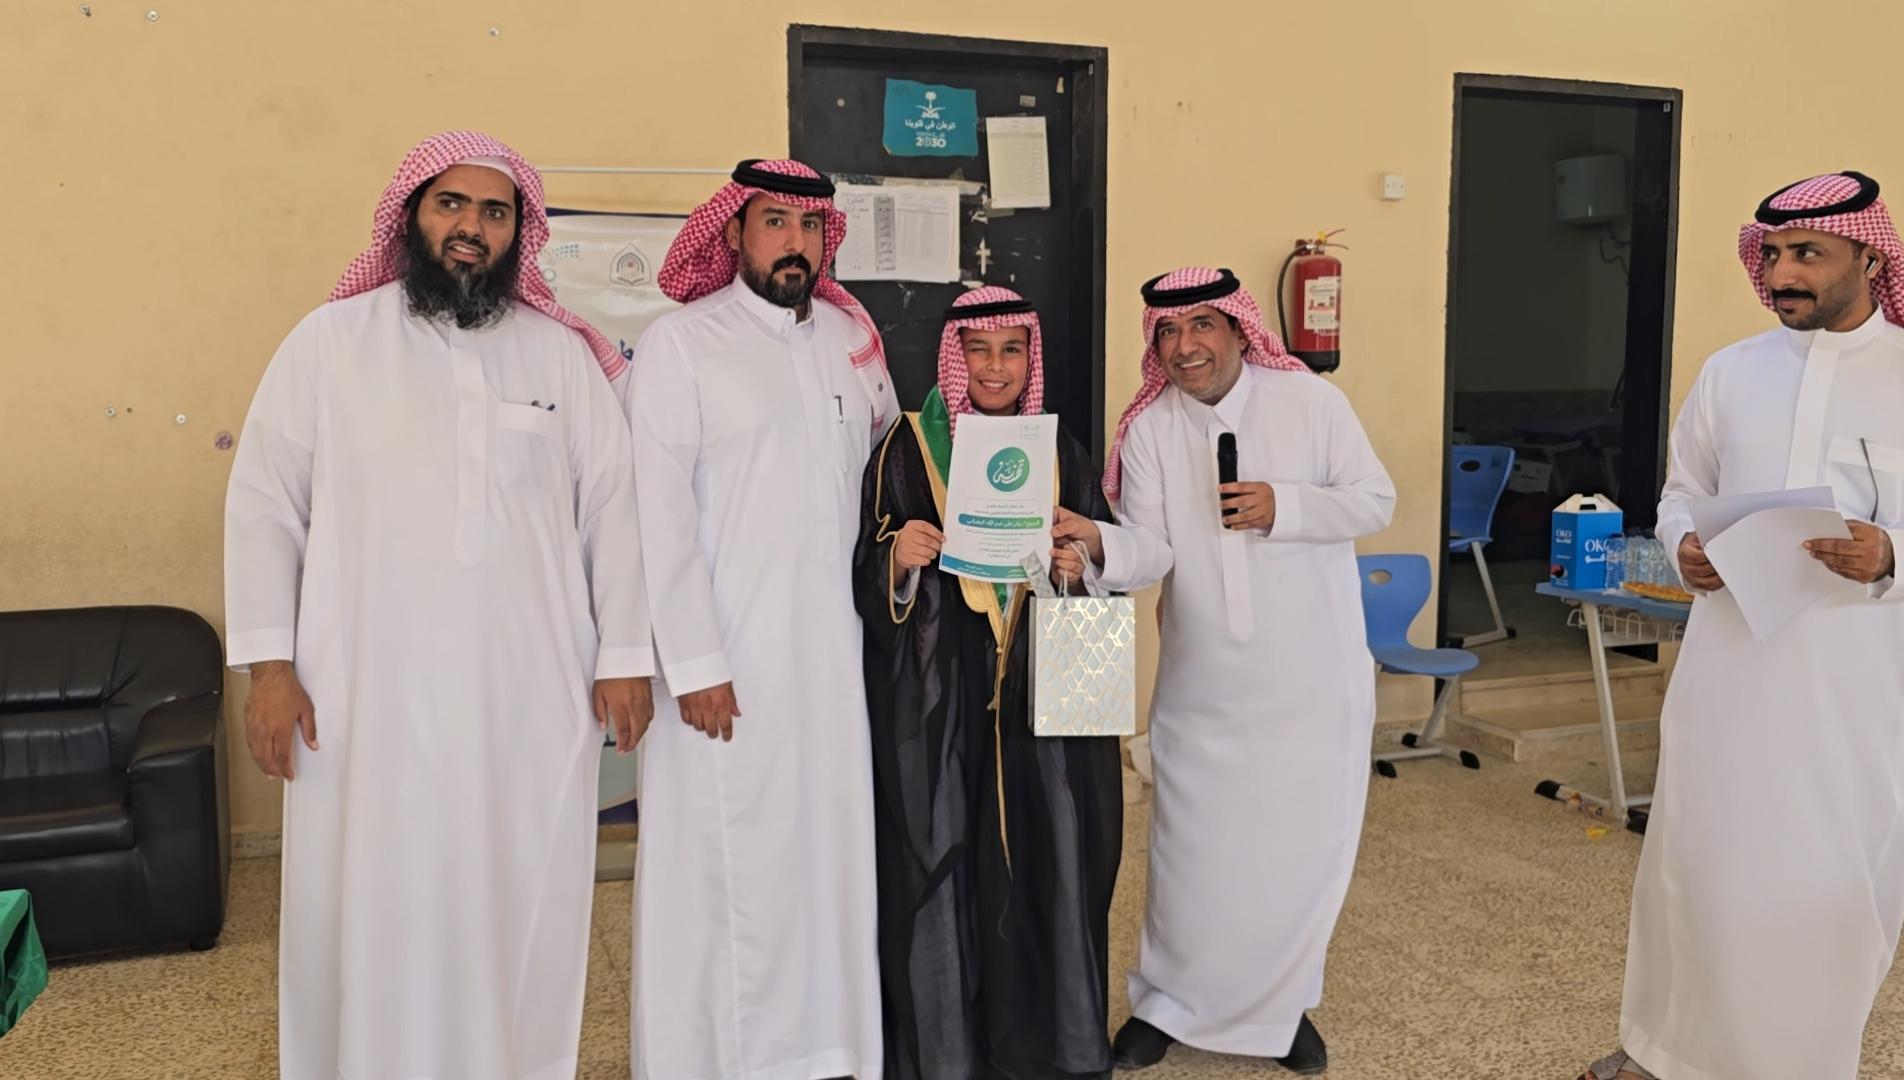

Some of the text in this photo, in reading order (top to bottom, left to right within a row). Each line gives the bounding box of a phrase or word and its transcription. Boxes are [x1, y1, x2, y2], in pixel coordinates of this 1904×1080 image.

[924, 119, 935, 130] في
[936, 120, 956, 130] الوطن
[915, 136, 947, 148] 2030
